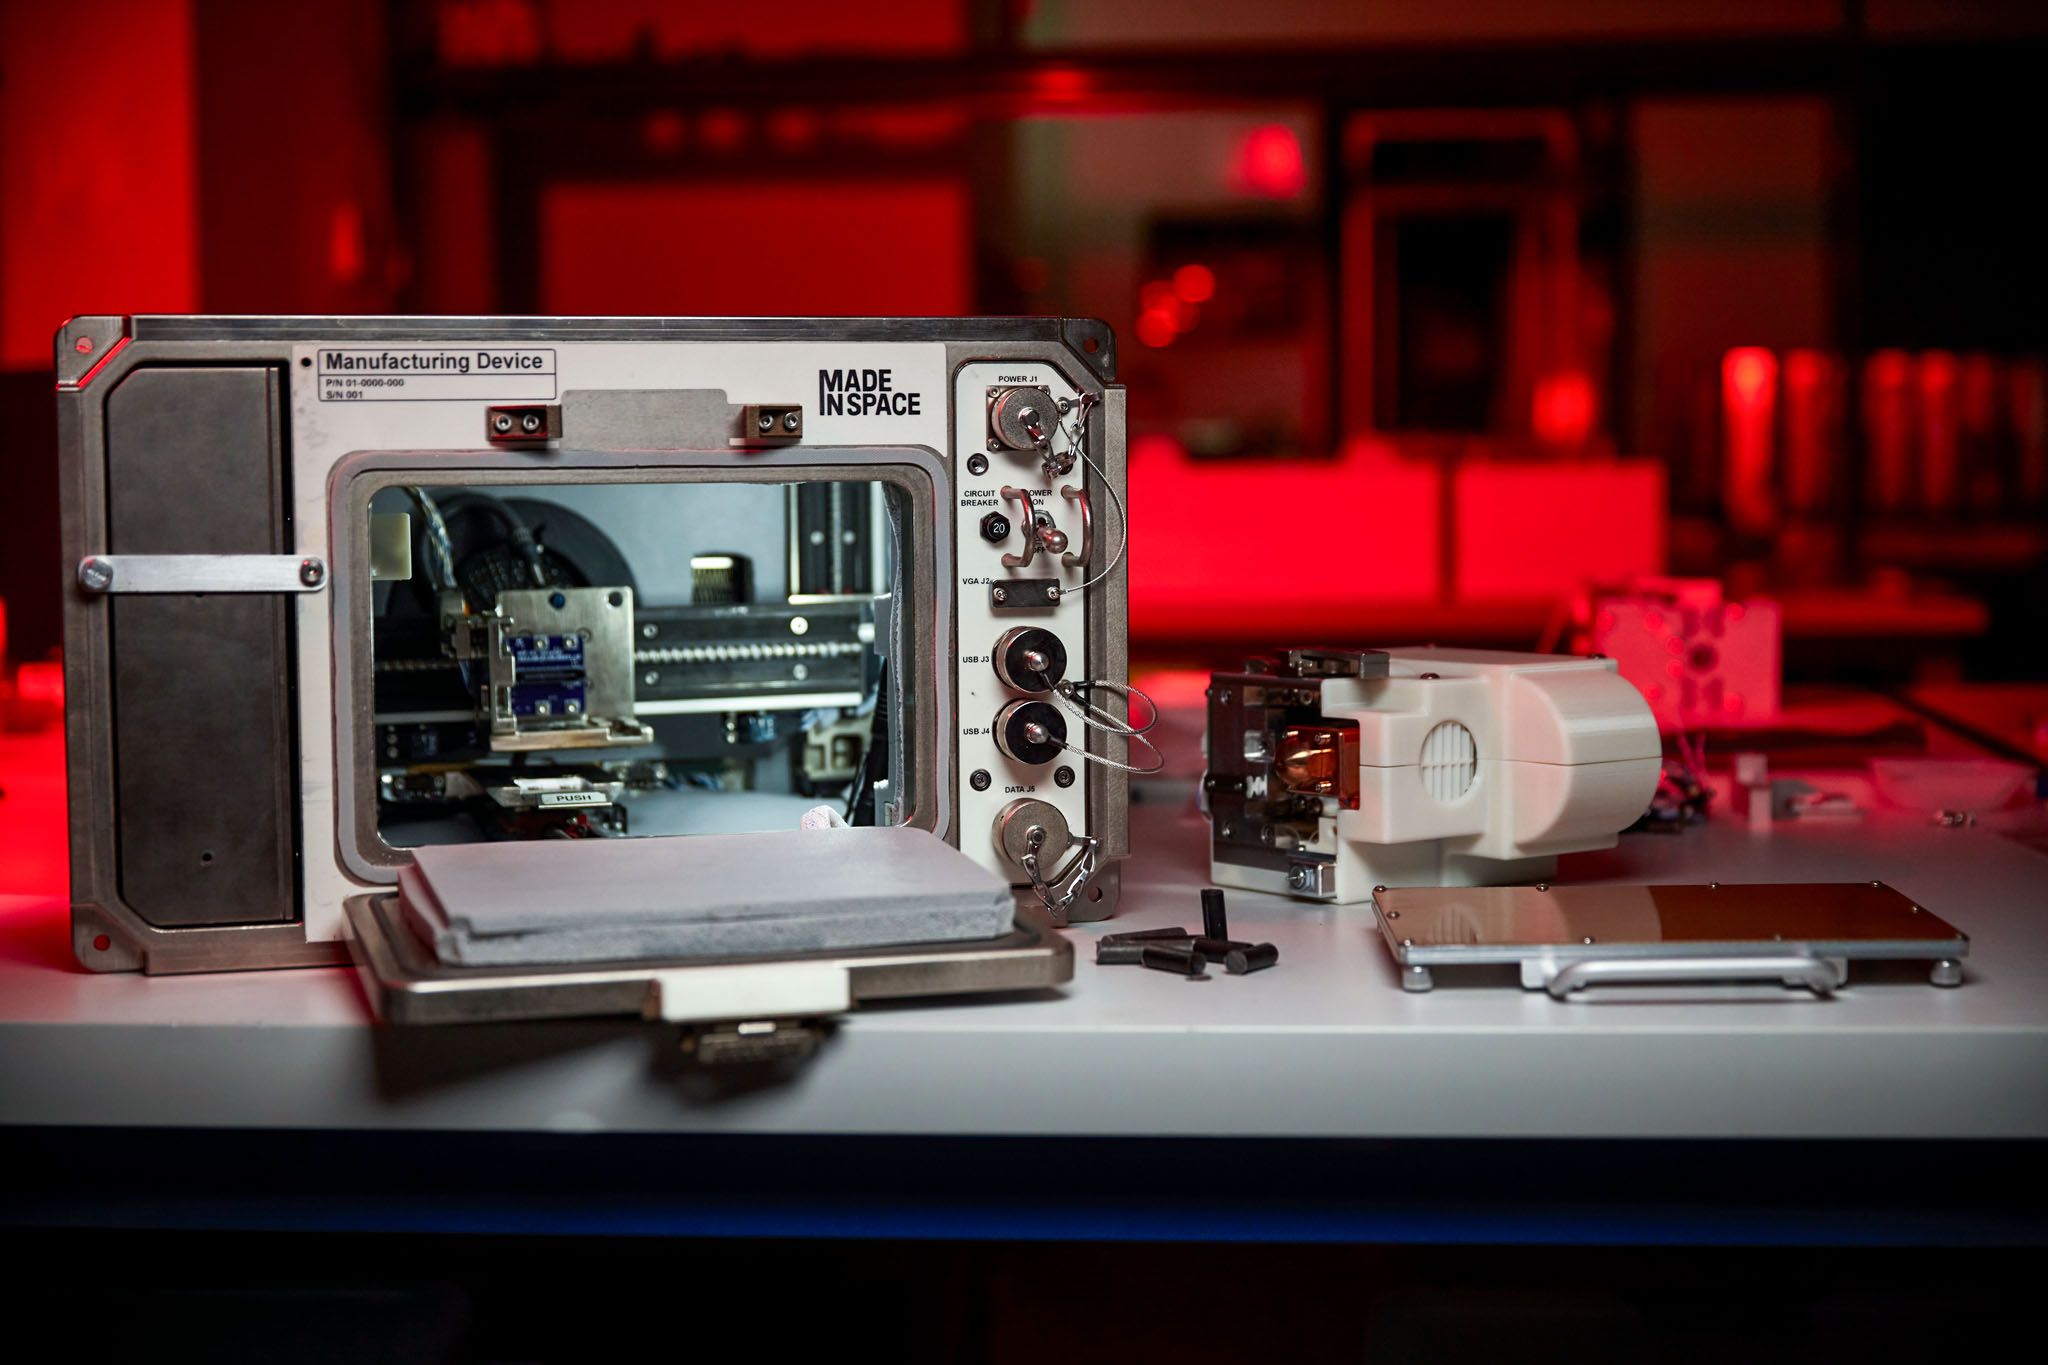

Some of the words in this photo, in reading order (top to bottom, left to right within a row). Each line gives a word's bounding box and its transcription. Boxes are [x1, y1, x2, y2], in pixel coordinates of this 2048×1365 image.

[326, 353, 470, 373] Manufacturing
[477, 353, 543, 369] Device
[326, 379, 343, 387] P/N
[346, 379, 405, 387] 01-0000-000
[819, 369, 892, 392] MADE
[326, 391, 343, 399] S/N
[346, 391, 362, 399] 001
[819, 393, 843, 416] IN
[847, 392, 920, 416] SPACE
[993, 523, 1005, 533] 20
